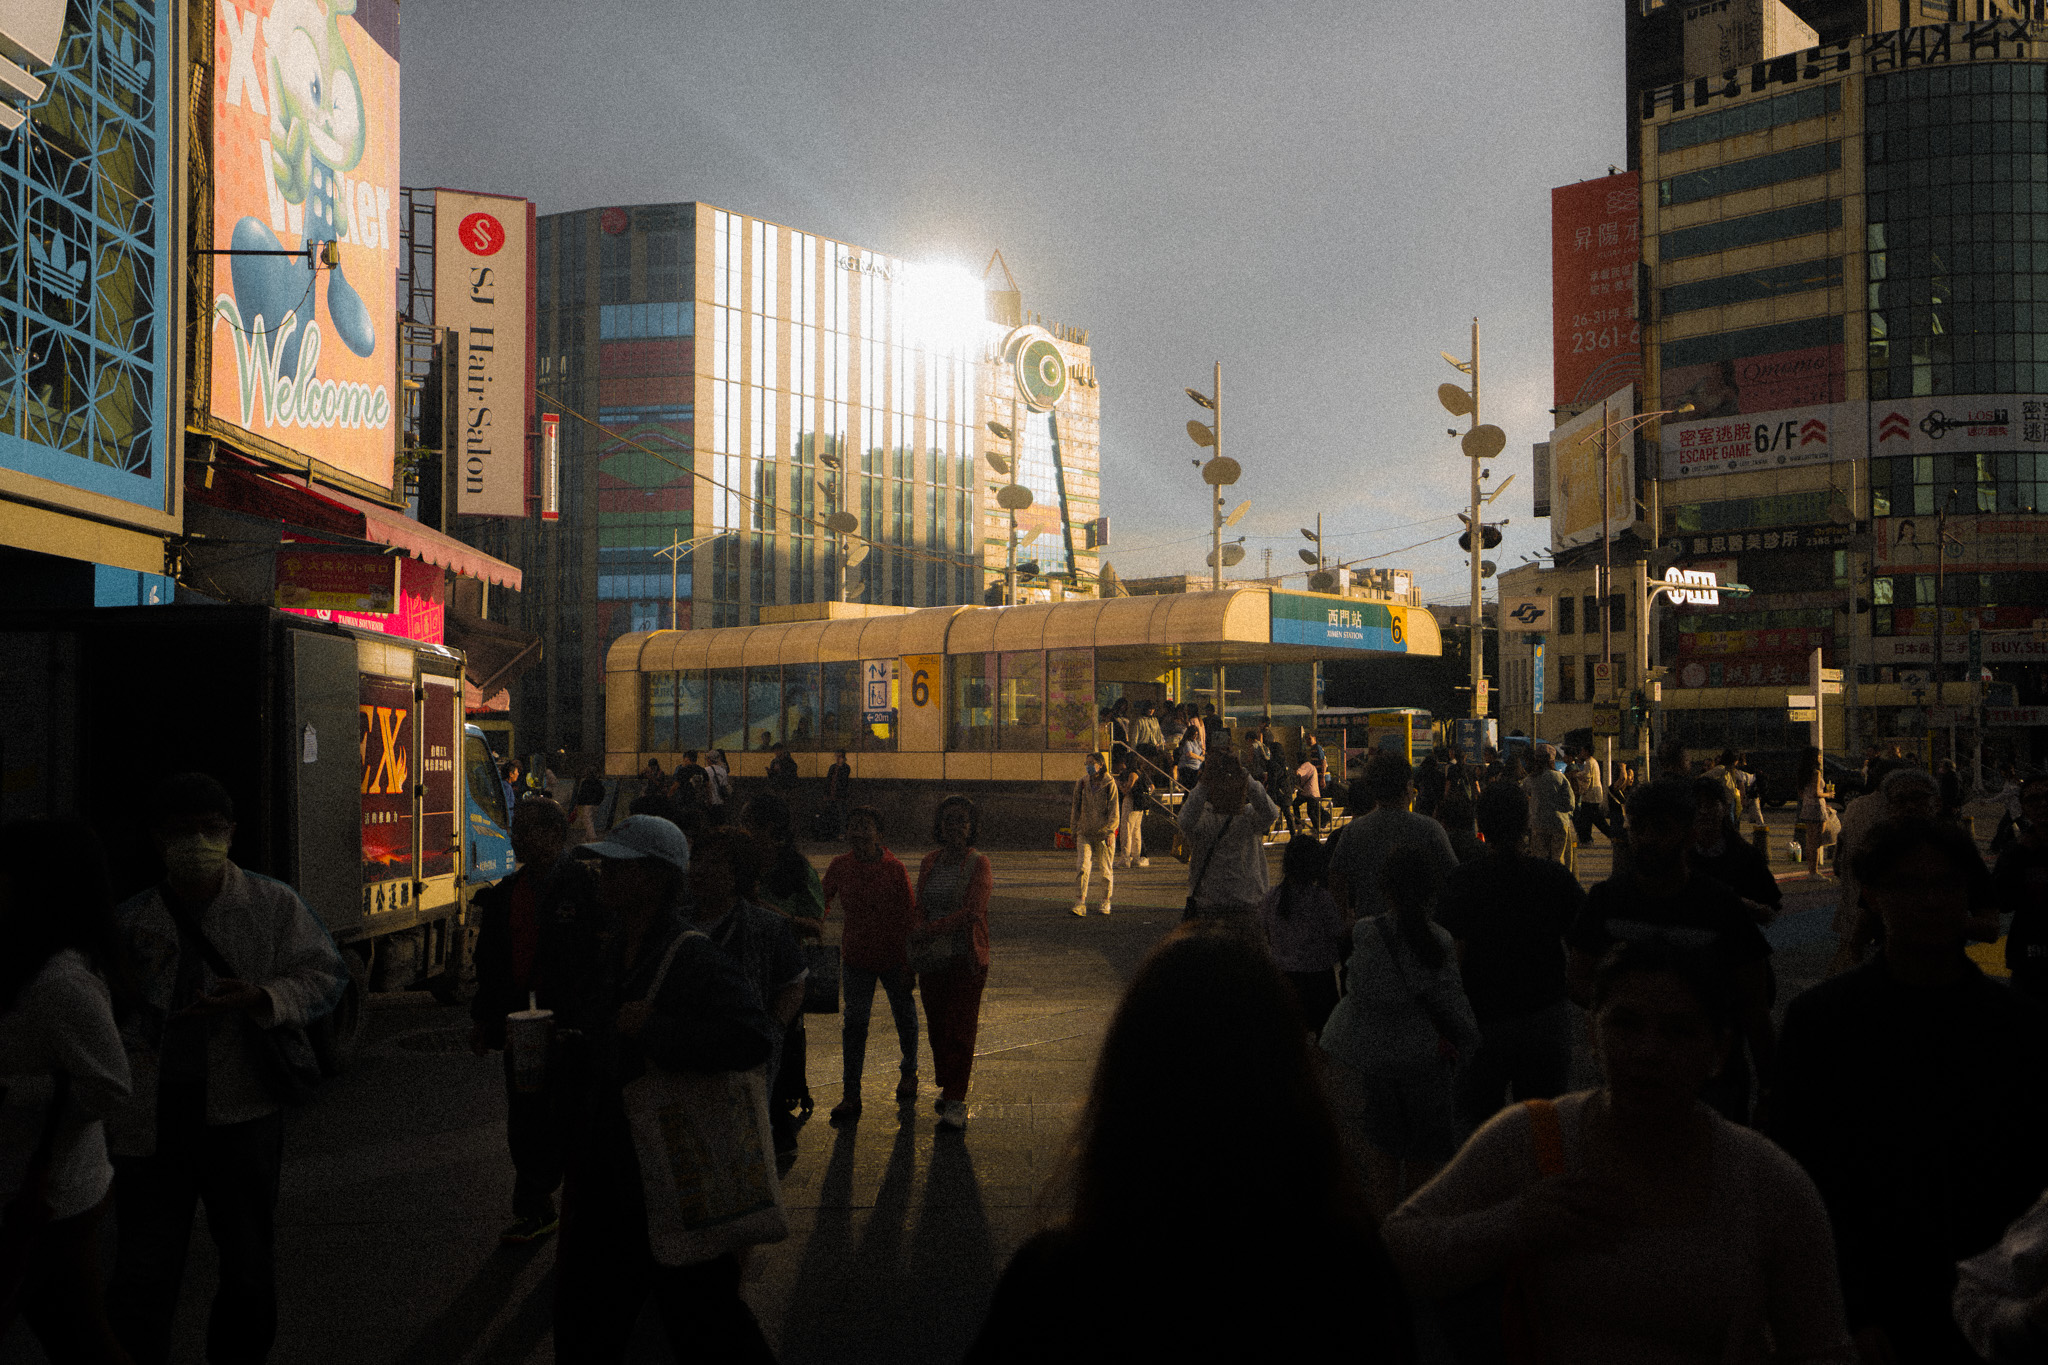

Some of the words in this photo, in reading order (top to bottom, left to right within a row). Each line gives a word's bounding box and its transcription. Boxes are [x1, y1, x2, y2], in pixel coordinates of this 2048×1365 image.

[469, 267, 495, 305] SJ
[213, 293, 390, 430] Welcome
[467, 326, 494, 401] Hair
[466, 407, 492, 495] Salon
[1679, 422, 1751, 448] 密室逃脫
[1754, 420, 1799, 453] 6/F
[1679, 446, 1719, 465] ESCAPE
[1721, 442, 1752, 460] GAME
[1326, 630, 1343, 639] XIMEN
[1343, 630, 1364, 640] STATION
[1327, 609, 1363, 630] 西門站
[1392, 616, 1403, 643] 6
[912, 669, 930, 707] 6
